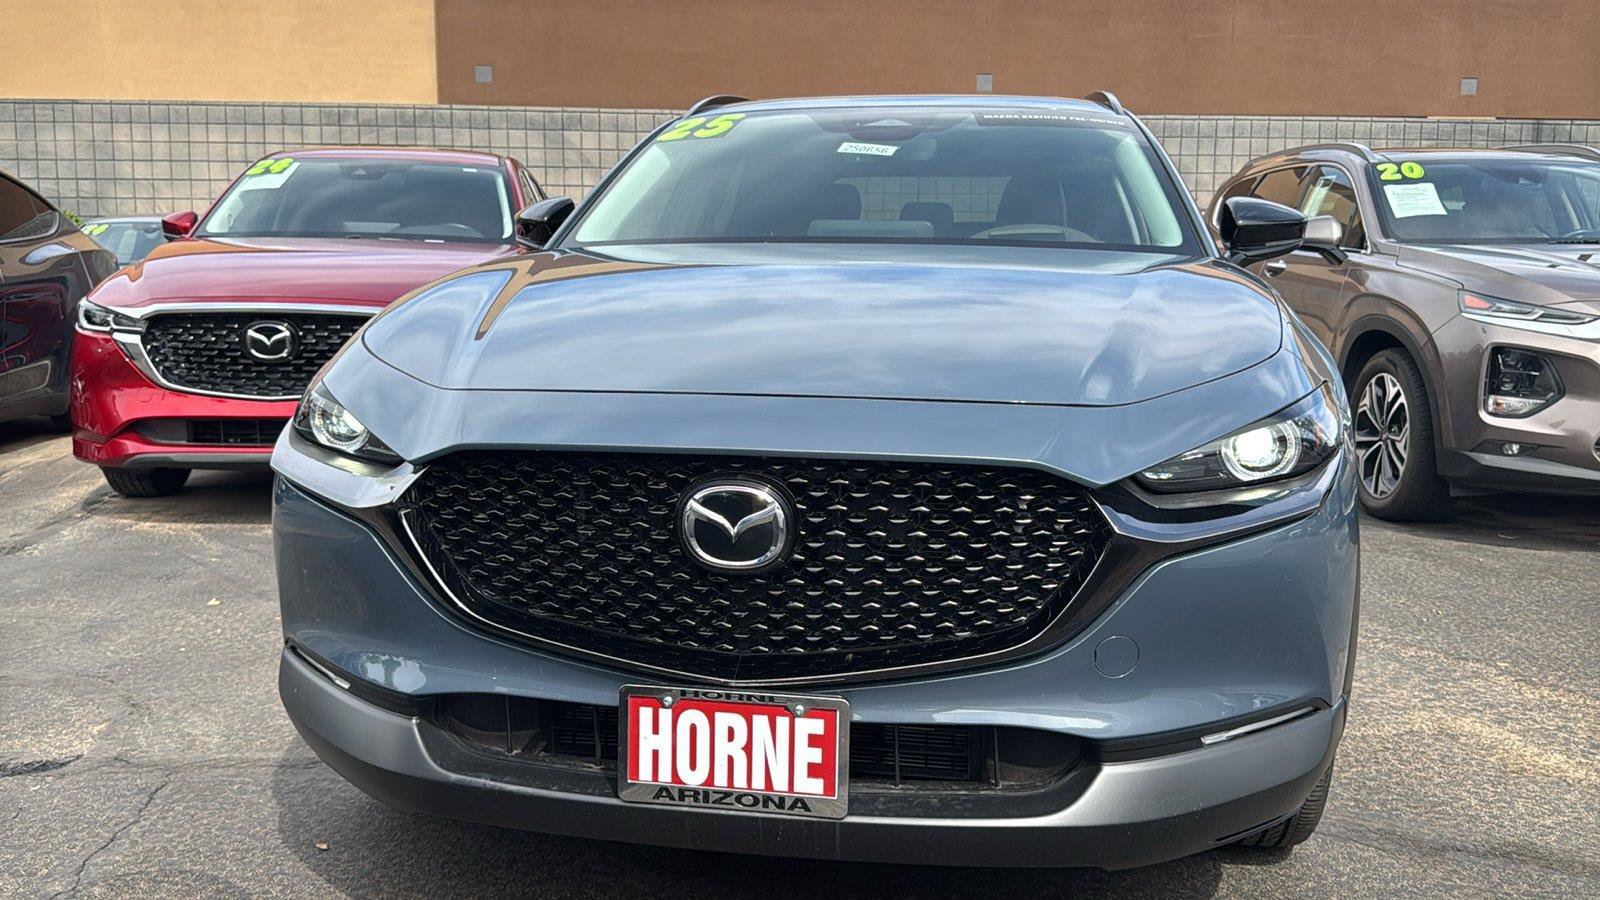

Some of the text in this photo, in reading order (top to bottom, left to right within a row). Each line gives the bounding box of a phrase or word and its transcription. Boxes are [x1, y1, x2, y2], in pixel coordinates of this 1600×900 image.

[656, 113, 747, 142] 25
[1376, 161, 1425, 181] 20
[638, 705, 825, 795] HORNE
[652, 786, 812, 813] ARIZONA
